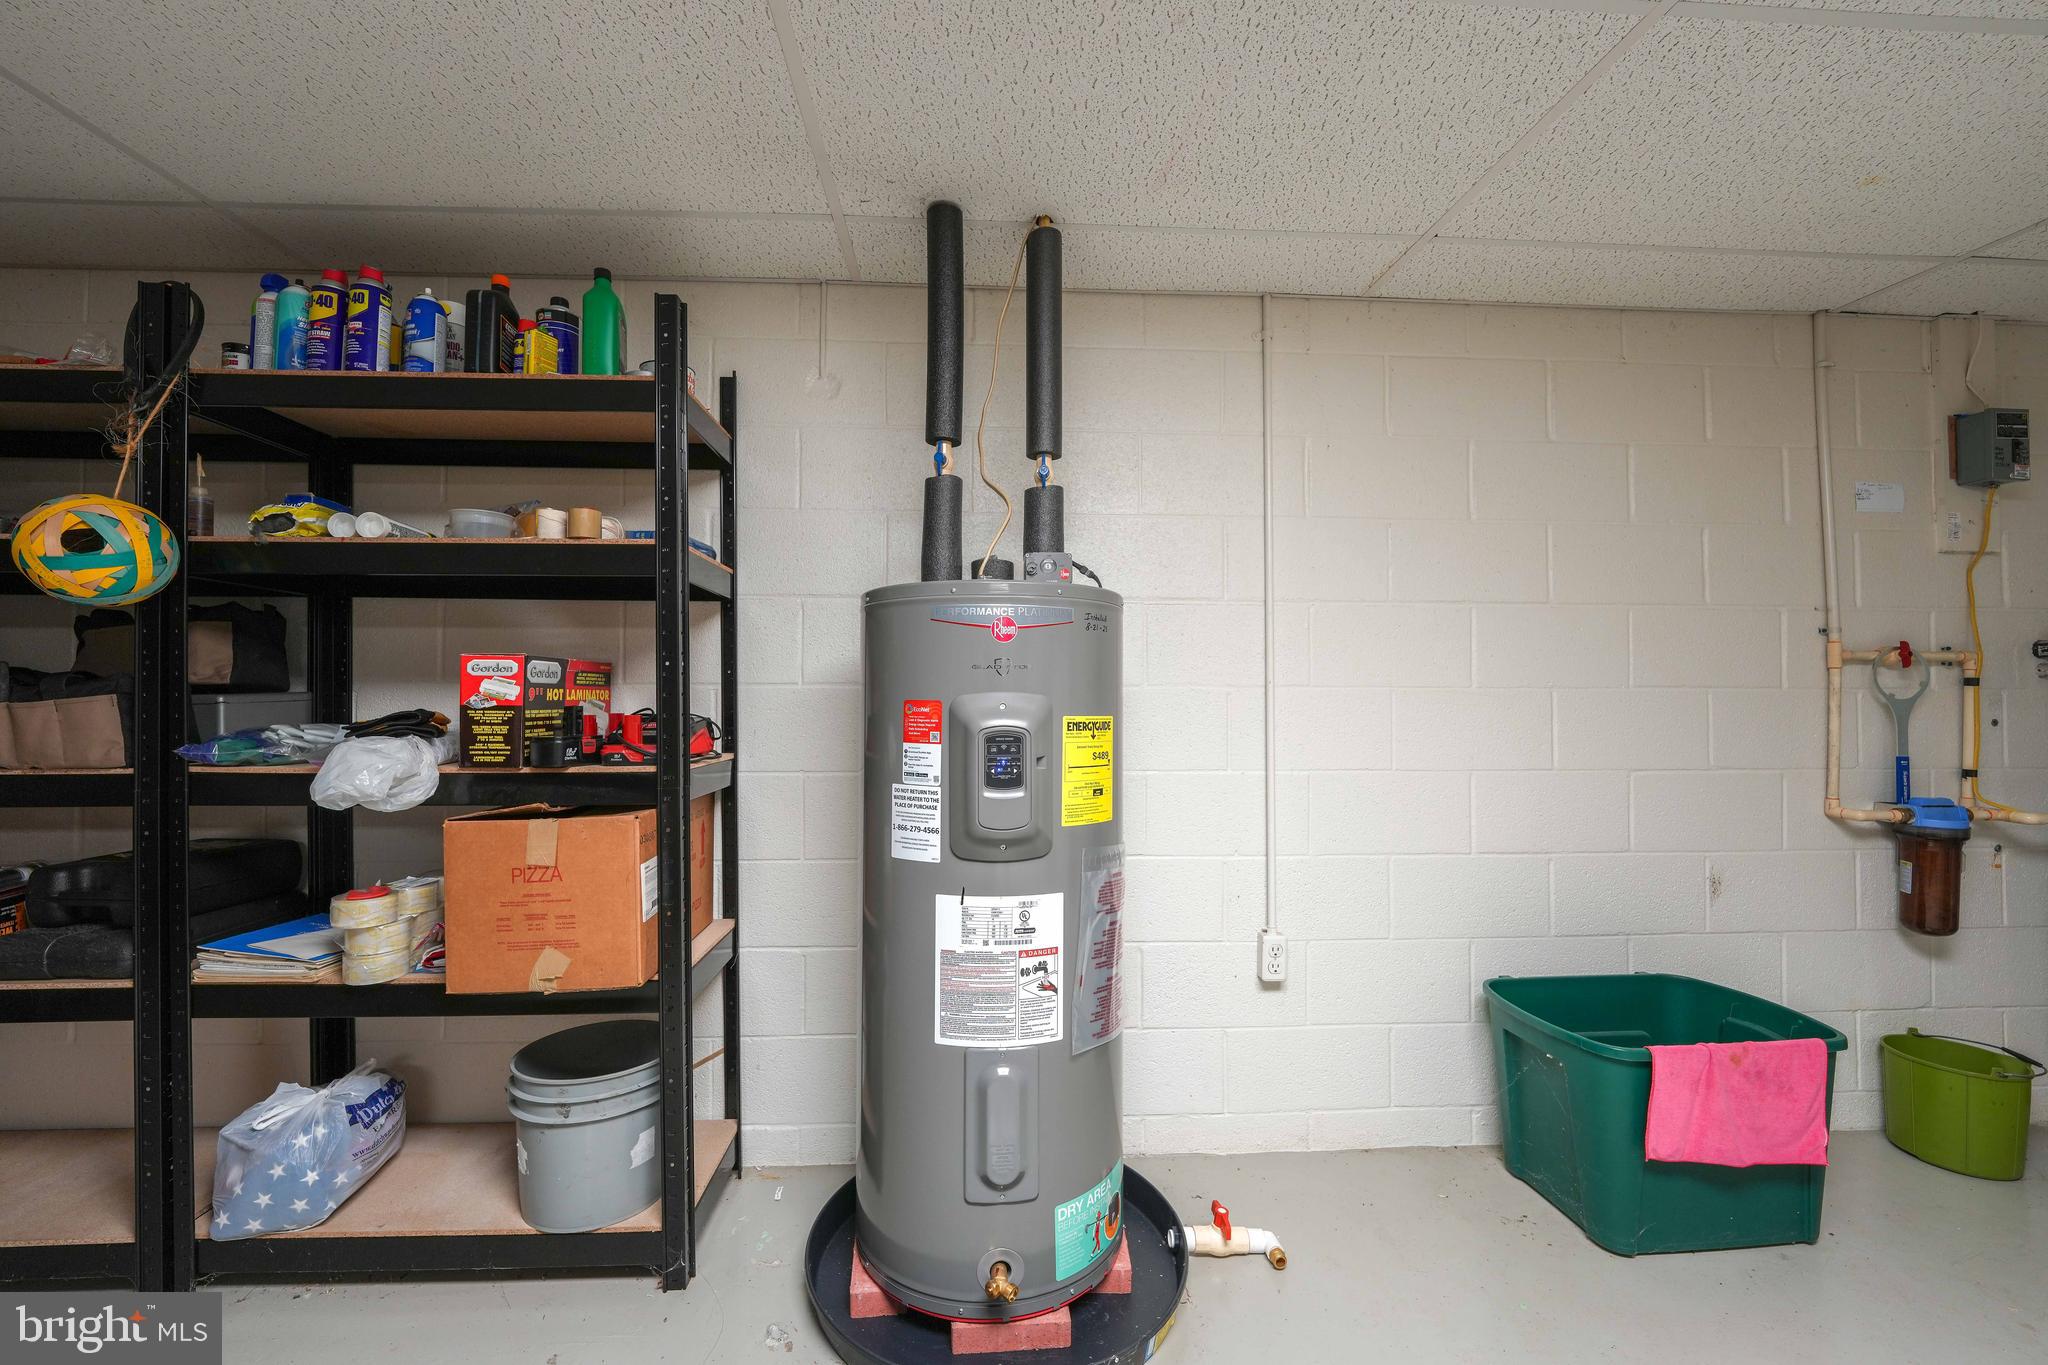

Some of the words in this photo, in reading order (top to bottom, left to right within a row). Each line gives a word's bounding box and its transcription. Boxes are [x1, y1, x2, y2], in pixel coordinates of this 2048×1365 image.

[310, 293, 334, 309] -40
[349, 291, 365, 304] -40
[994, 616, 1016, 638] Rheem
[471, 663, 513, 673] Gordon
[530, 666, 558, 679] Gordon
[546, 688, 564, 701] HOT
[566, 688, 610, 701] LAMINATOR
[892, 823, 940, 835] 1-866-279-4566
[511, 865, 563, 884] PIZZA
[1028, 948, 1056, 957] DANGER
[1058, 1198, 1084, 1221] DRY
[1086, 1178, 1112, 1208] AREA
